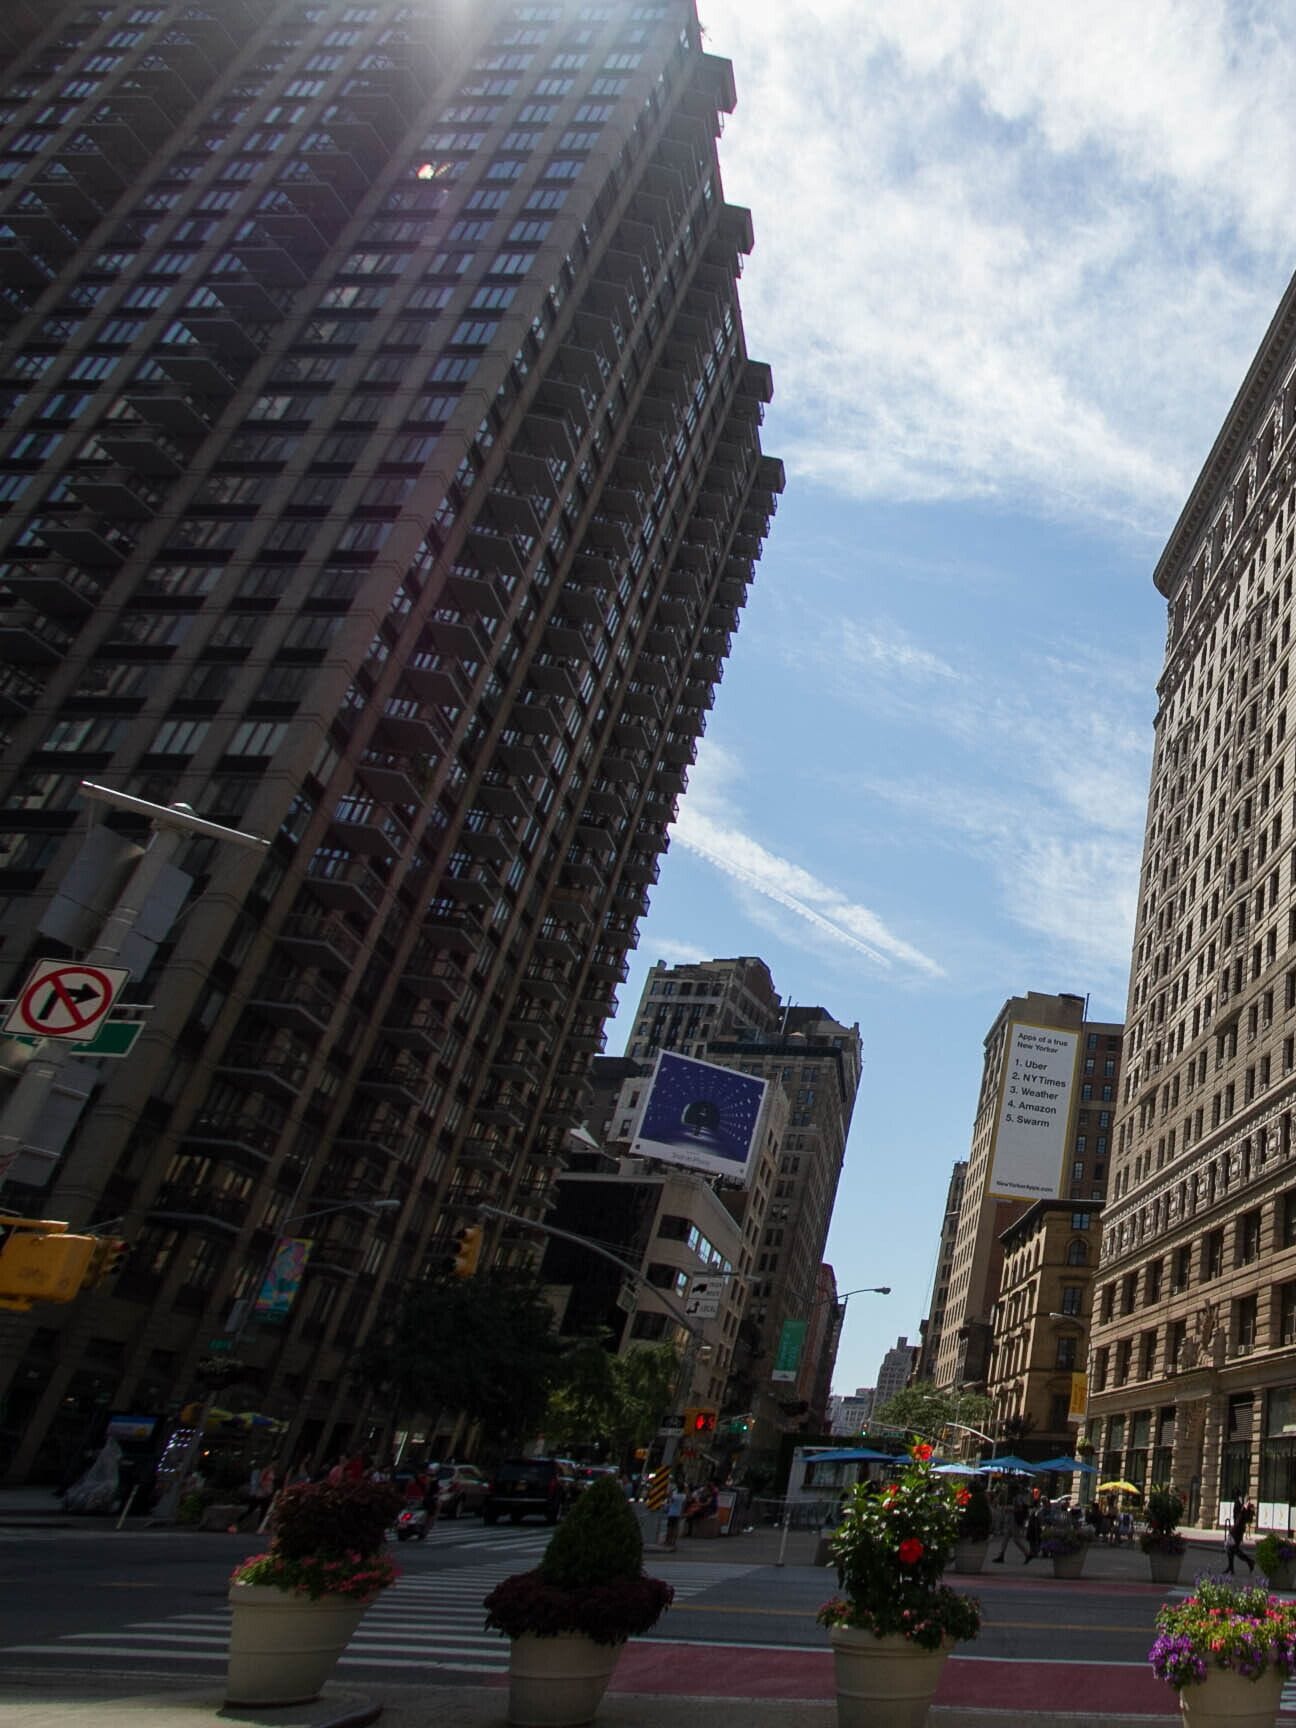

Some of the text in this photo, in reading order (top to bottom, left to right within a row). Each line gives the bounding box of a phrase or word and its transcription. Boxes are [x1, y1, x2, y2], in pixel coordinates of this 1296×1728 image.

[1018, 1032, 1037, 1042] Apps
[1053, 1038, 1069, 1047] true
[1017, 1041, 1058, 1053] New Yorker
[1015, 1058, 1048, 1070] 1. Uber
[1012, 1072, 1020, 1081] 2.
[1010, 1086, 1058, 1100] 3. Weather
[1008, 1100, 1057, 1114] 4. Amazon
[1005, 1114, 1049, 1127] 5. Swarm
